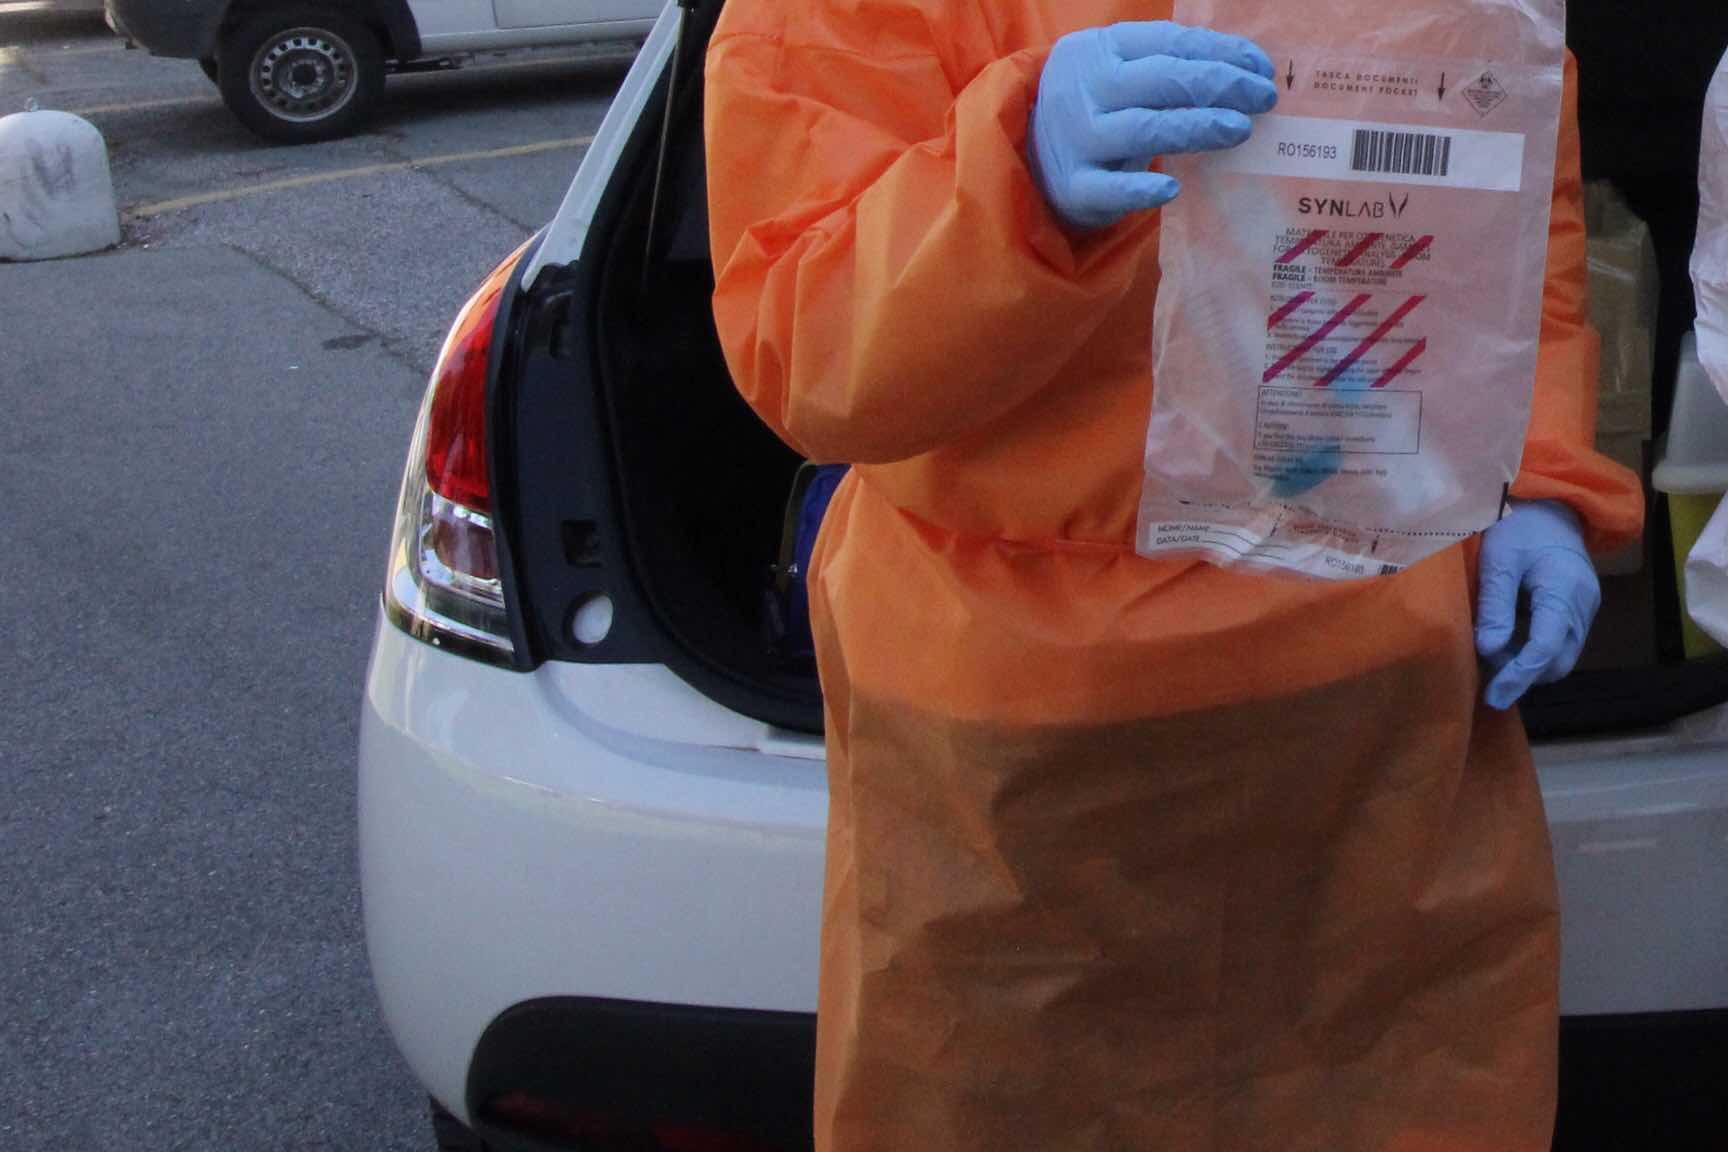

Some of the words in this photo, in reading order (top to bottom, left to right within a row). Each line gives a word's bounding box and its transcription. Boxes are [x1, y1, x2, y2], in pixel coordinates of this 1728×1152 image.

[1316, 70, 1351, 83] TASCA
[1356, 73, 1419, 86] DOCUMENTI
[1314, 81, 1374, 94] DOCUMENT
[1379, 85, 1418, 97] POCKET
[1298, 196, 1385, 218] SYNLAB
[1273, 264, 1306, 273] FRAGILE
[1272, 272, 1305, 282] FRAGILE
